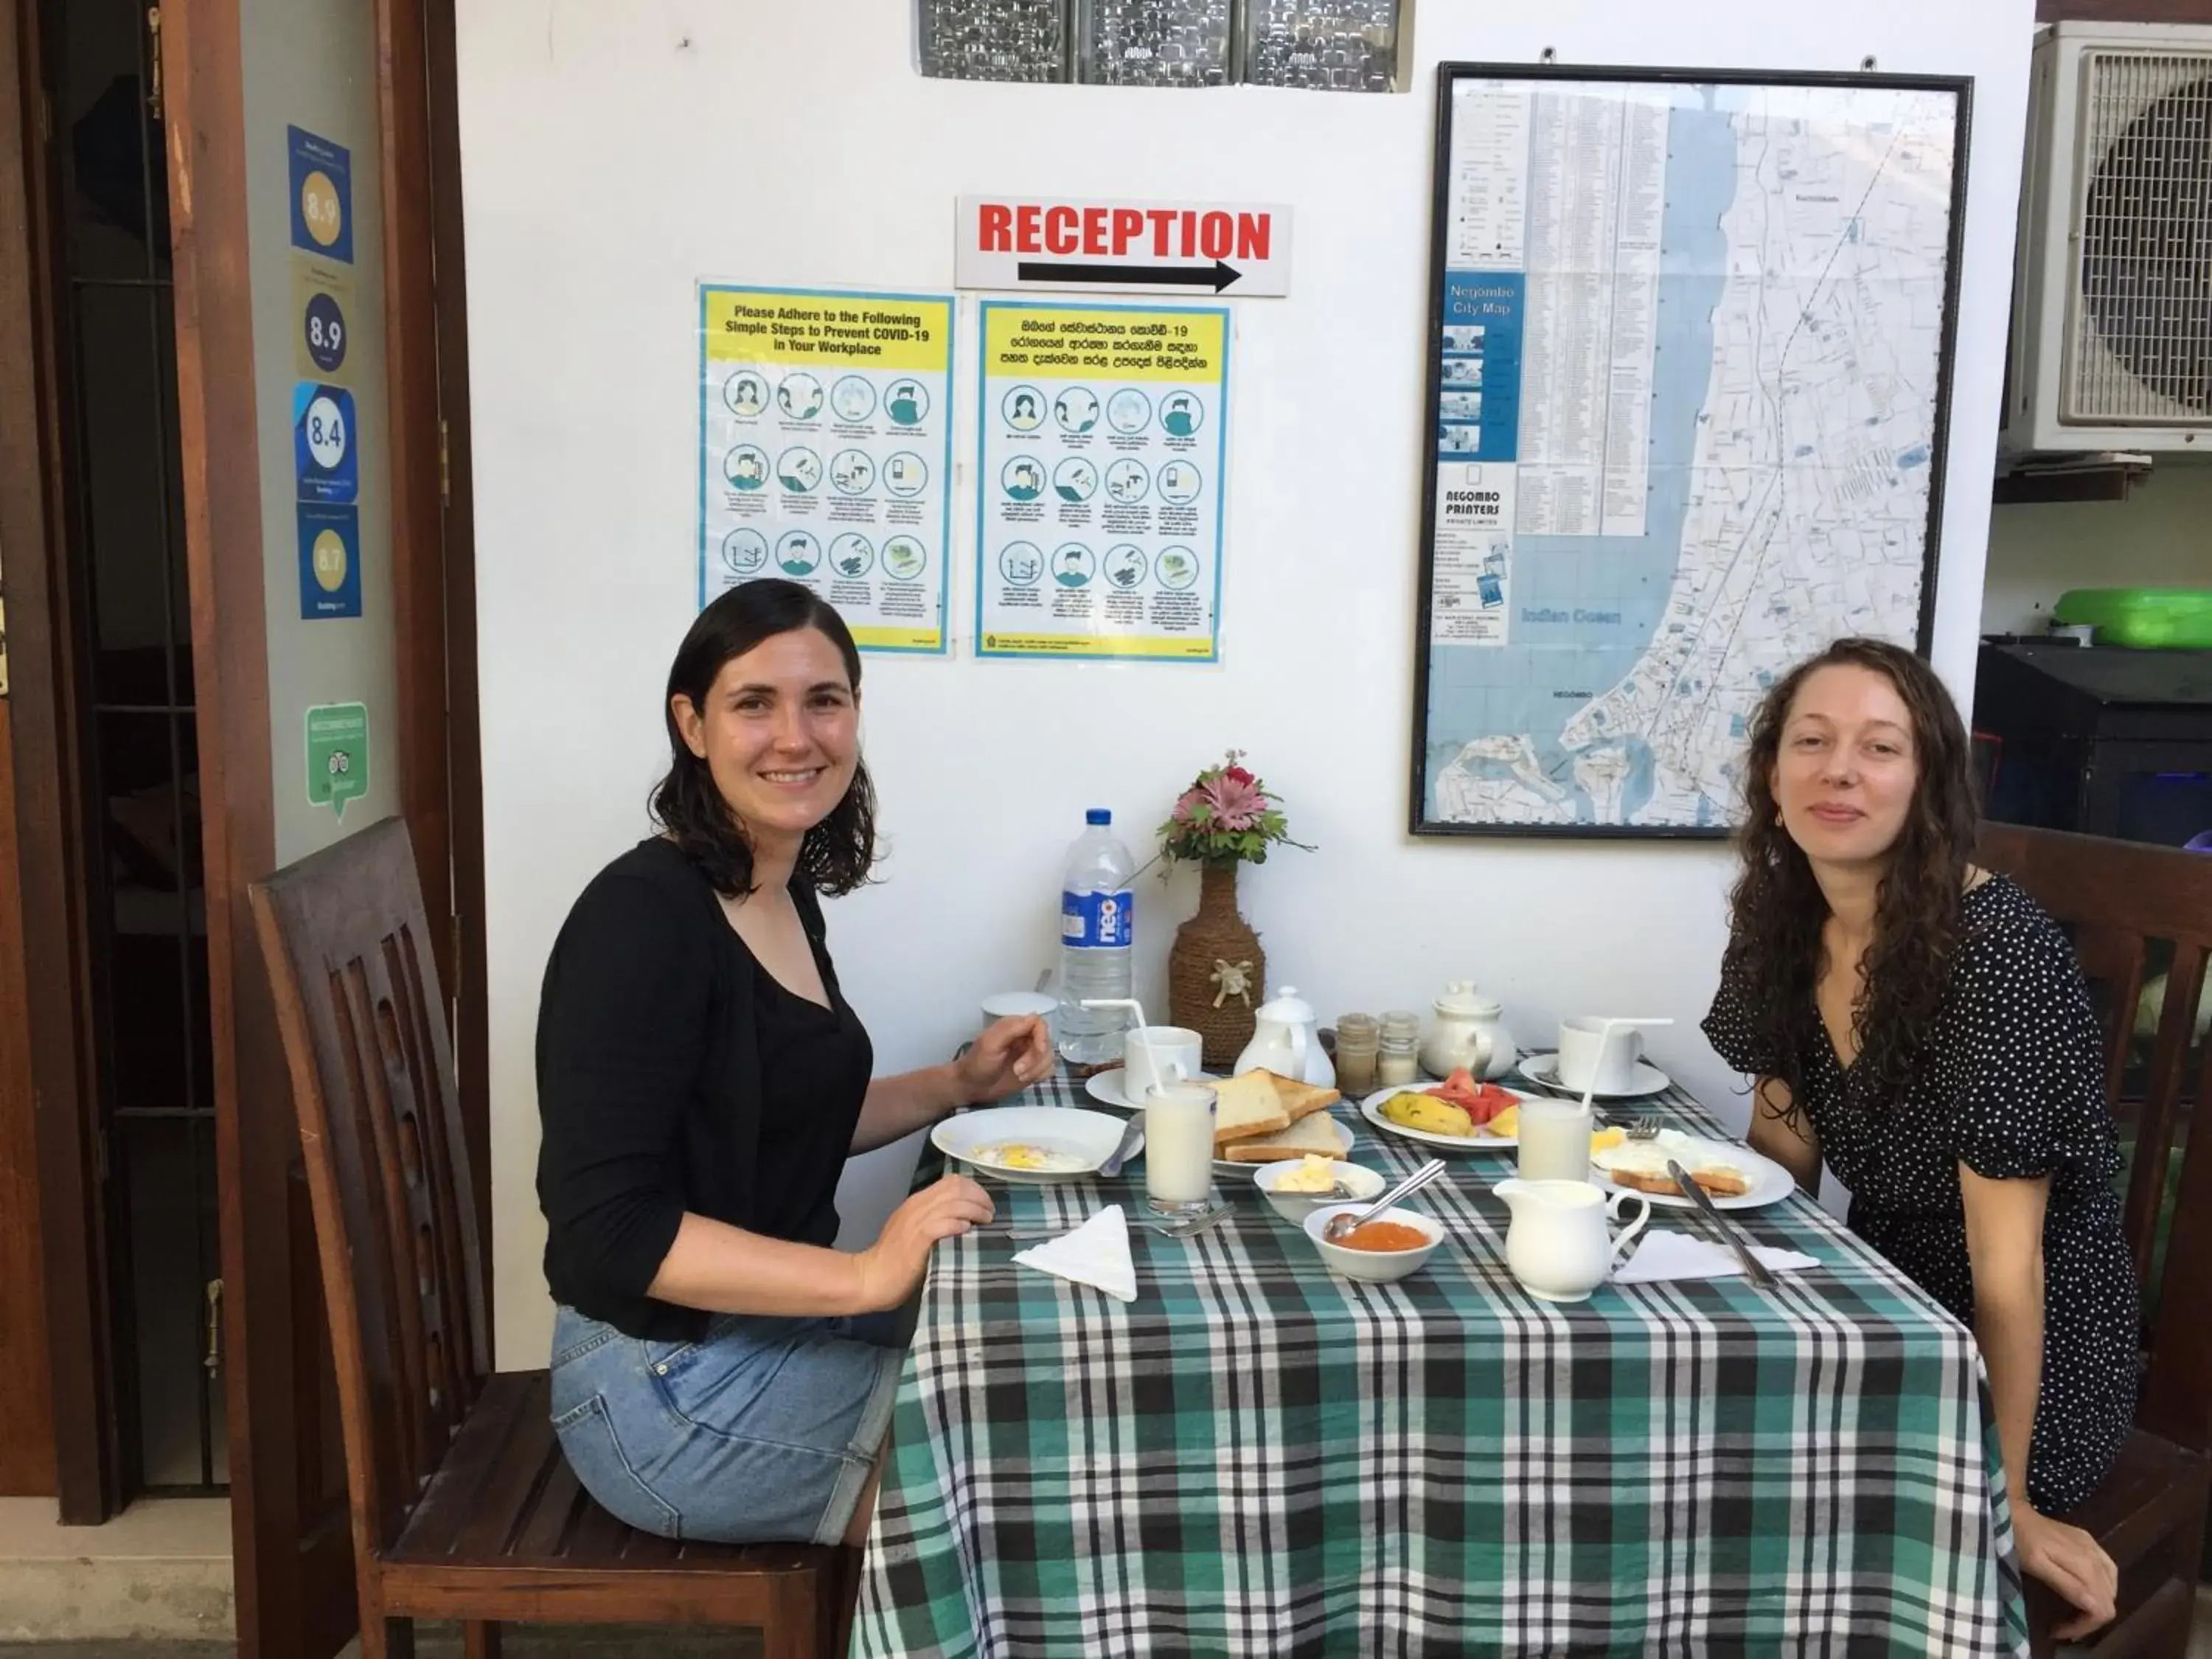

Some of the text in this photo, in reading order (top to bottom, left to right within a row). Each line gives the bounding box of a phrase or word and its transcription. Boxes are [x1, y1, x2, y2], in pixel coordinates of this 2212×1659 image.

[308, 192, 336, 226] 8.9
[979, 204, 1270, 260] RECEPTION
[1450, 284, 1514, 299] Negombo
[734, 305, 921, 328] Please Adhere to the Following
[1453, 302, 1511, 316] City Map
[310, 316, 341, 350] 8.9
[725, 320, 930, 342] Simple Steps to Prevent COVID-19
[788, 339, 815, 352] Your
[818, 341, 882, 356] Workplace
[312, 416, 341, 448] 8.4
[1446, 490, 1500, 502] NEGOMBO
[1446, 504, 1500, 515] PRINTERS
[319, 548, 341, 571] 8.7
[1099, 899, 1117, 943] neo
